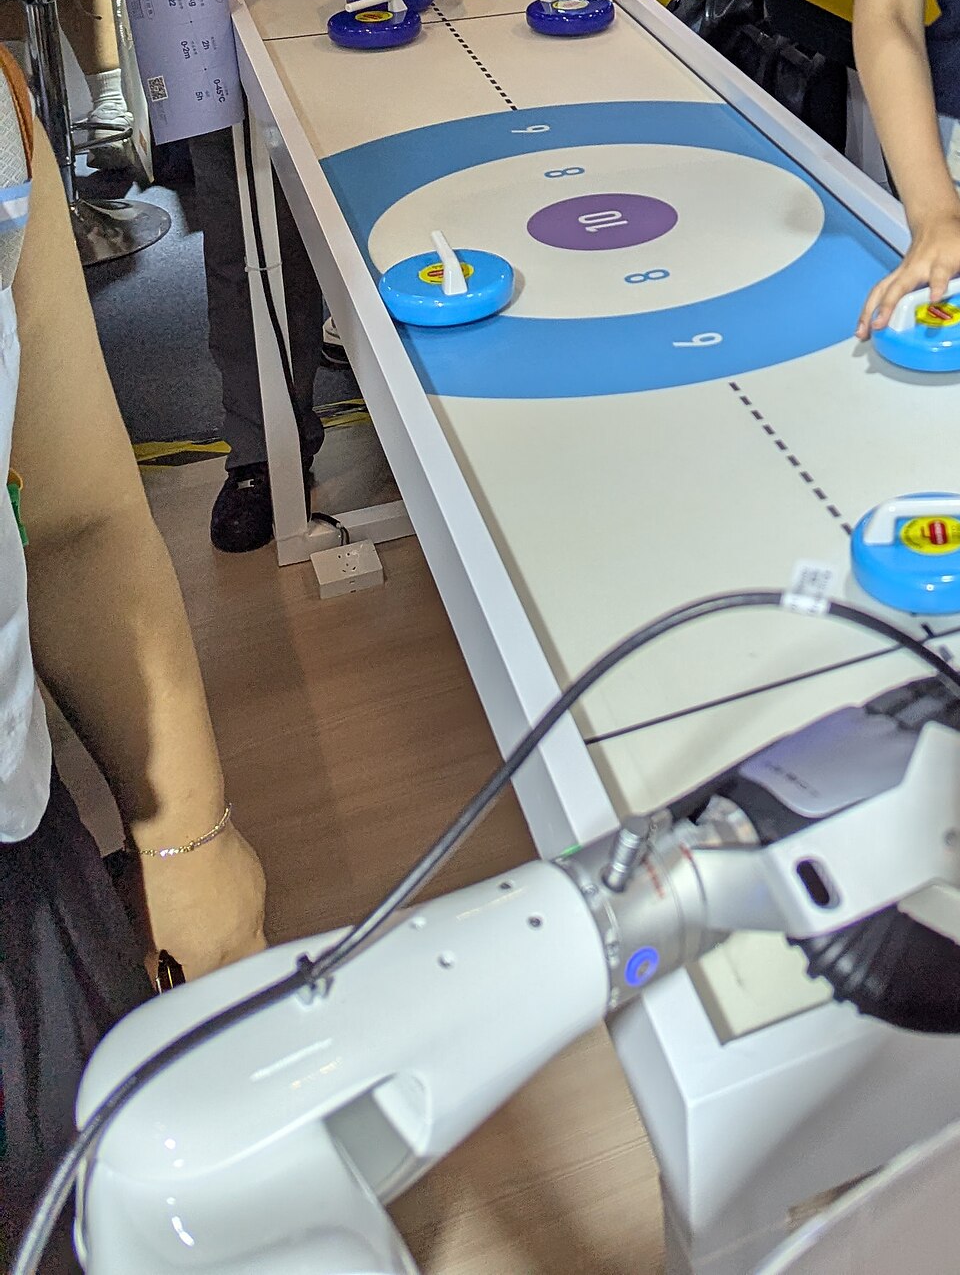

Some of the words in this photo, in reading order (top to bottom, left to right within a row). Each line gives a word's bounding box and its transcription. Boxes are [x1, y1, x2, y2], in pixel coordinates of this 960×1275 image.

[544, 166, 585, 179] 8
[578, 210, 628, 233] 10
[624, 269, 671, 284] 8
